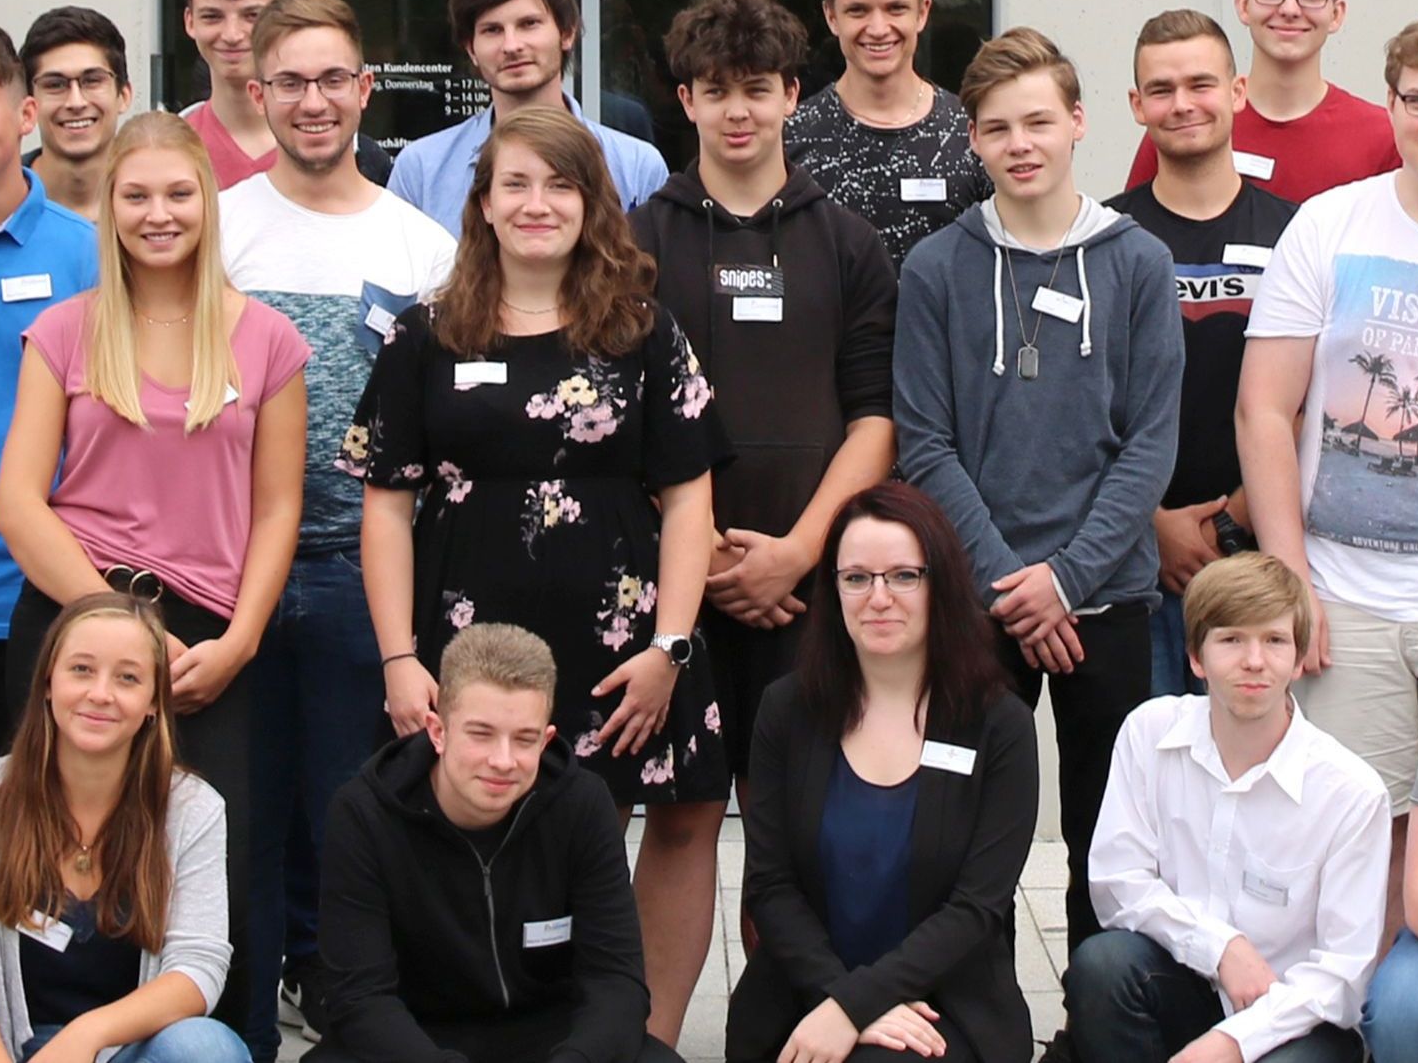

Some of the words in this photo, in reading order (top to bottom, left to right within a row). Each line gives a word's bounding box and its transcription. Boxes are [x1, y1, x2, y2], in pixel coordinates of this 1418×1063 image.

[383, 62, 452, 73] Kundencenter
[384, 79, 434, 91] Donnerstag
[444, 79, 451, 89] 9
[462, 79, 472, 89] 17
[444, 92, 451, 102] 9
[462, 92, 472, 102] 14
[474, 92, 490, 102] Uhr
[444, 105, 451, 115] 9
[462, 105, 472, 115] 13
[1361, 327, 1386, 348] OF
